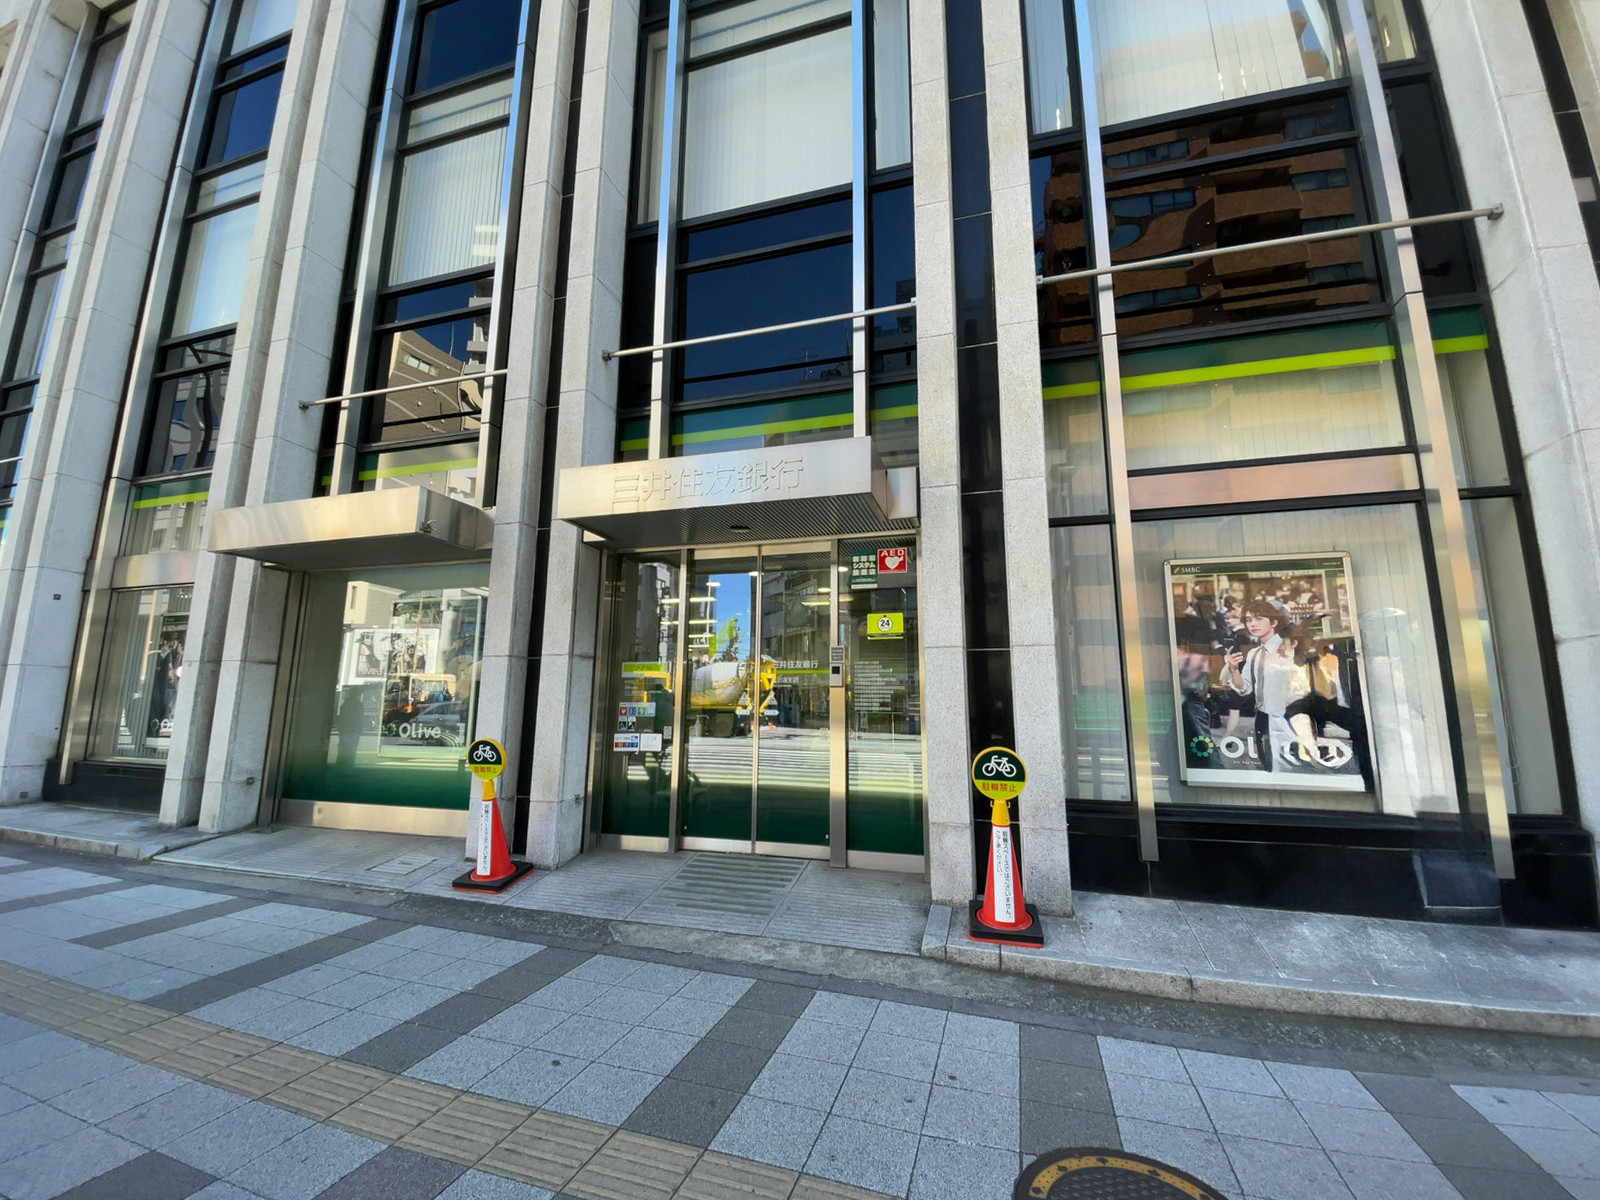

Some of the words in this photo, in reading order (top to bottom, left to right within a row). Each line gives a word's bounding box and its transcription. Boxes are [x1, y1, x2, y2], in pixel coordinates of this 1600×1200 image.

[612, 456, 804, 502] 三井住友銀行
[880, 549, 905, 557] AED
[880, 619, 890, 627] 24
[772, 660, 819, 669] 三井住友銀行
[399, 722, 441, 739] Olive
[981, 782, 1017, 793] 駐輪禁止
